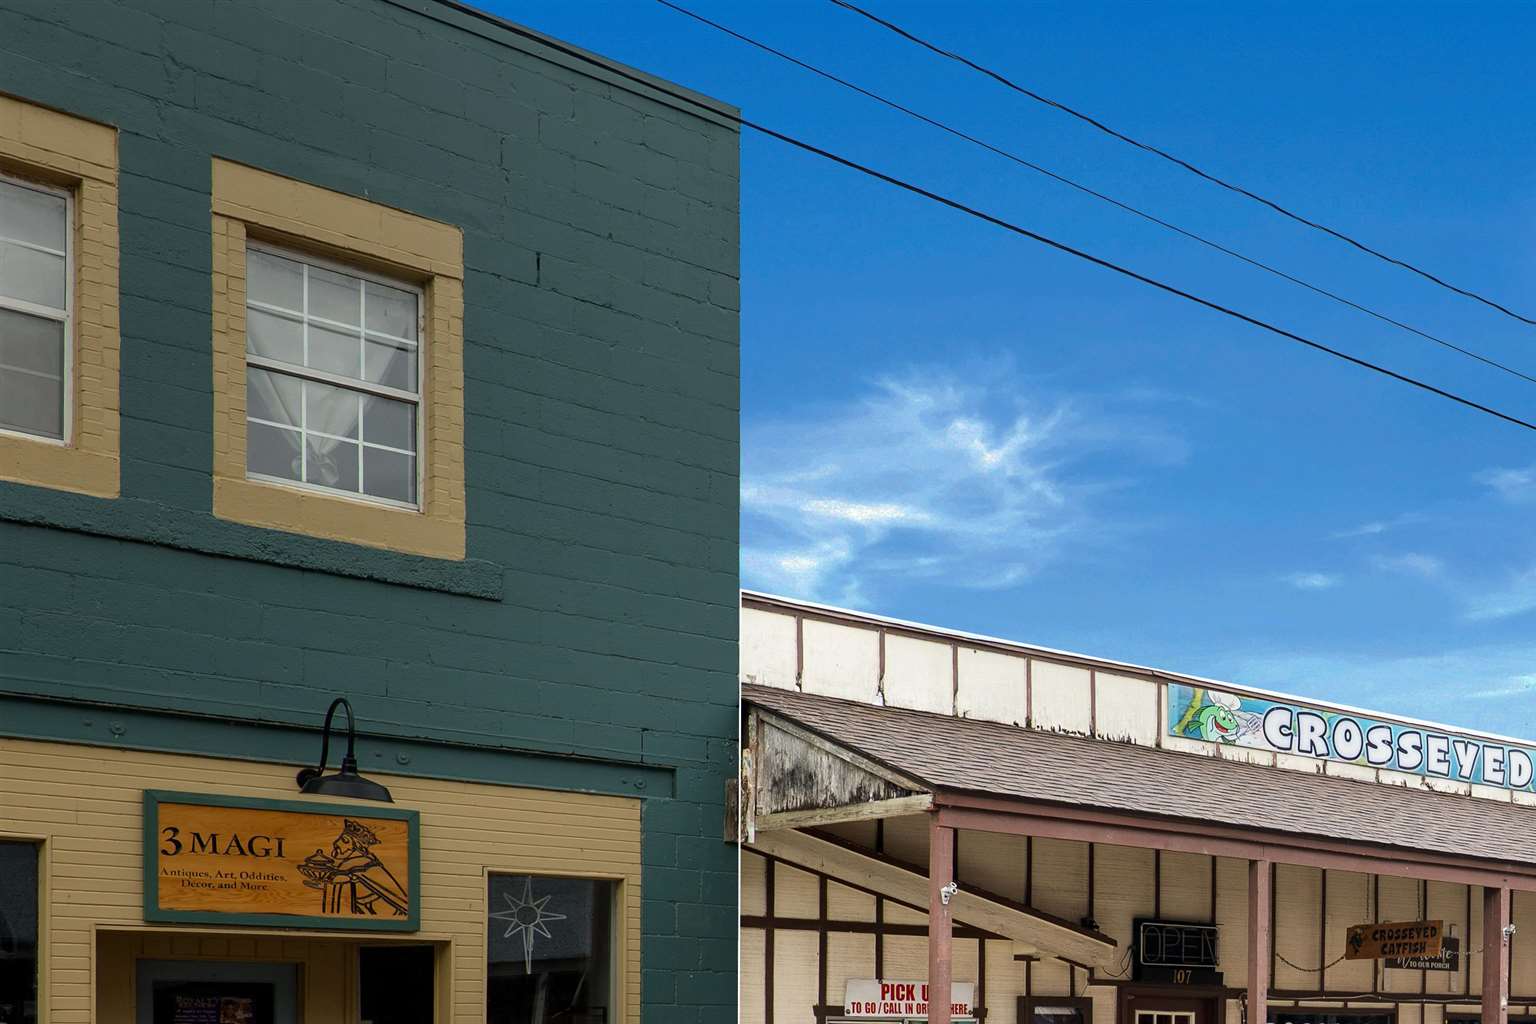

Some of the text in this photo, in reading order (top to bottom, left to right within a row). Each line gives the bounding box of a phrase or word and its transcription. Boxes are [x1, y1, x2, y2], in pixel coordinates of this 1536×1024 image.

[1262, 706, 1533, 788] CROSSEYED
[160, 826, 286, 858] 3 MAGI
[160, 867, 213, 879] Antiques,
[215, 869, 237, 881] Art,
[217, 880, 237, 890] and
[240, 881, 268, 892] More
[1371, 926, 1438, 941] CROSSEYED
[1144, 926, 1217, 963] OPEN
[1380, 942, 1427, 956] CATFISH
[1409, 960, 1419, 968] TO
[1431, 961, 1450, 969] PORCH
[1173, 969, 1192, 985] 107
[881, 983, 915, 1002] PICK
[851, 1001, 862, 1014] TO
[865, 1002, 876, 1015] GO
[883, 1002, 903, 1015] CALL
[905, 1002, 913, 1015] IN
[951, 1003, 968, 1016] HERE
